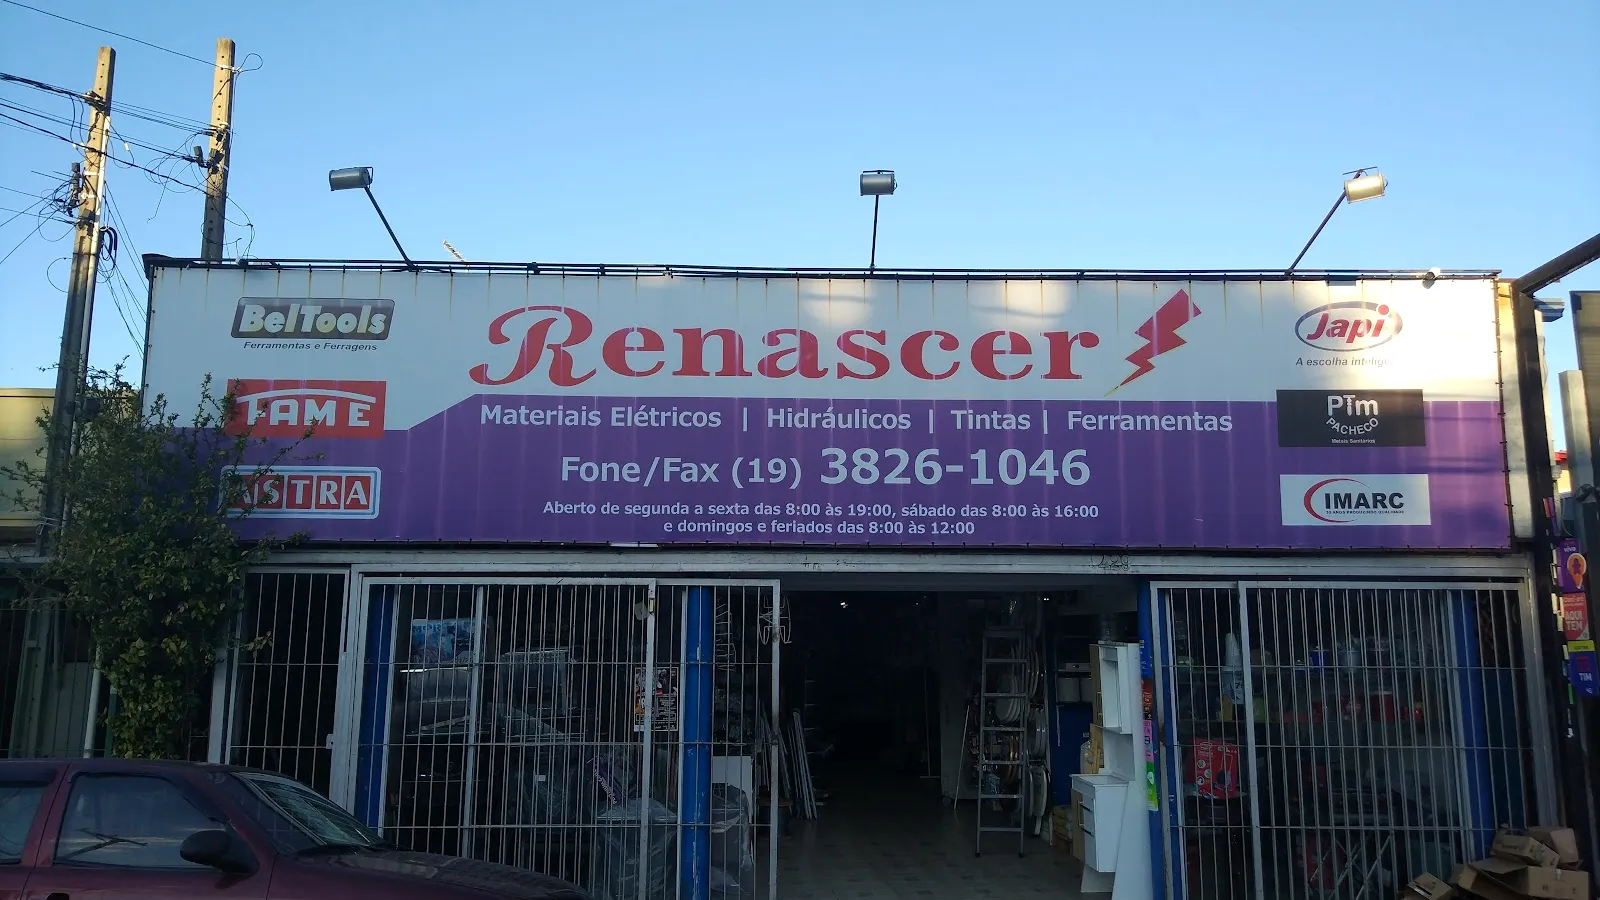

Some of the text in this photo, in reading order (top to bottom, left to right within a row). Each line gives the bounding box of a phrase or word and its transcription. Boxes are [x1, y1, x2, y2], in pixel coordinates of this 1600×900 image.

[239, 304, 386, 334] BelTools
[1307, 305, 1389, 343] Japi
[243, 341, 311, 349] Ferramentas
[323, 342, 378, 352] Ferragens
[469, 305, 1100, 387] Renascer
[1296, 357, 1303, 366] A
[1307, 357, 1348, 366] escolha
[237, 389, 375, 427] FAME
[480, 404, 602, 427] Materiais
[610, 404, 722, 428] Elétricos
[767, 407, 912, 430] Hidráulicos
[951, 409, 1031, 430] Tintas
[1068, 410, 1233, 432] Ferramentas
[1326, 417, 1379, 435] PACHECO
[561, 447, 1091, 490] Fone/Fax (19) 3826-1046
[543, 501, 1099, 519] Aberto de segunda a sexta das 8:00 às 19:00, sábado das 8:00 às 16:00
[1325, 492, 1404, 510] IMARC
[663, 520, 975, 535] e domingos e feriados das 8:00 às 12:00
[1579, 672, 1593, 682] TIM
